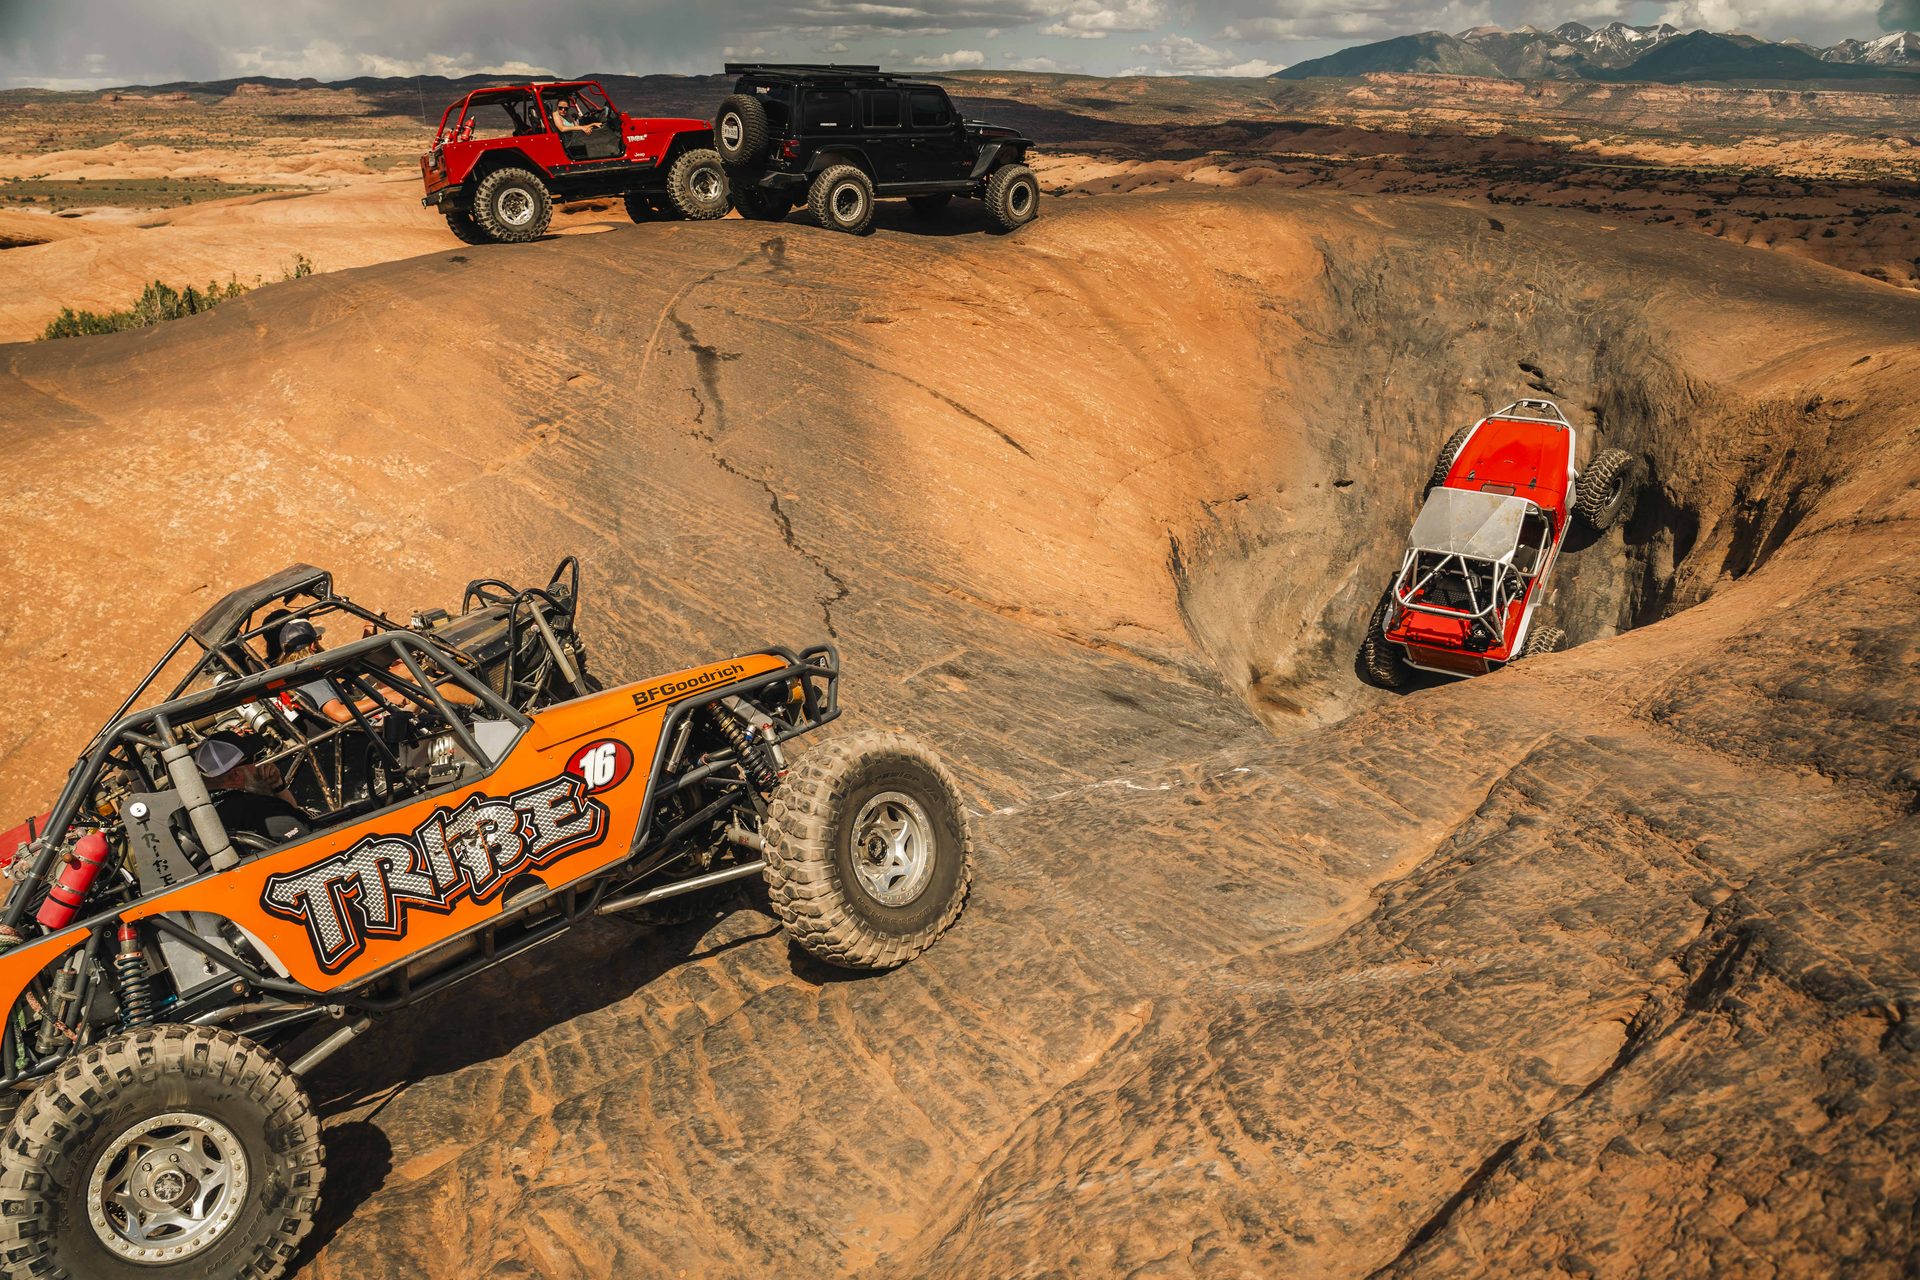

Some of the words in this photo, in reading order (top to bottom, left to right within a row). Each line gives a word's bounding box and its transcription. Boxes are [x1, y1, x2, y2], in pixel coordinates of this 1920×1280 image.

[632, 664, 745, 706] BFGoodrich
[579, 743, 616, 790] 16
[264, 775, 603, 966] TRIBE
